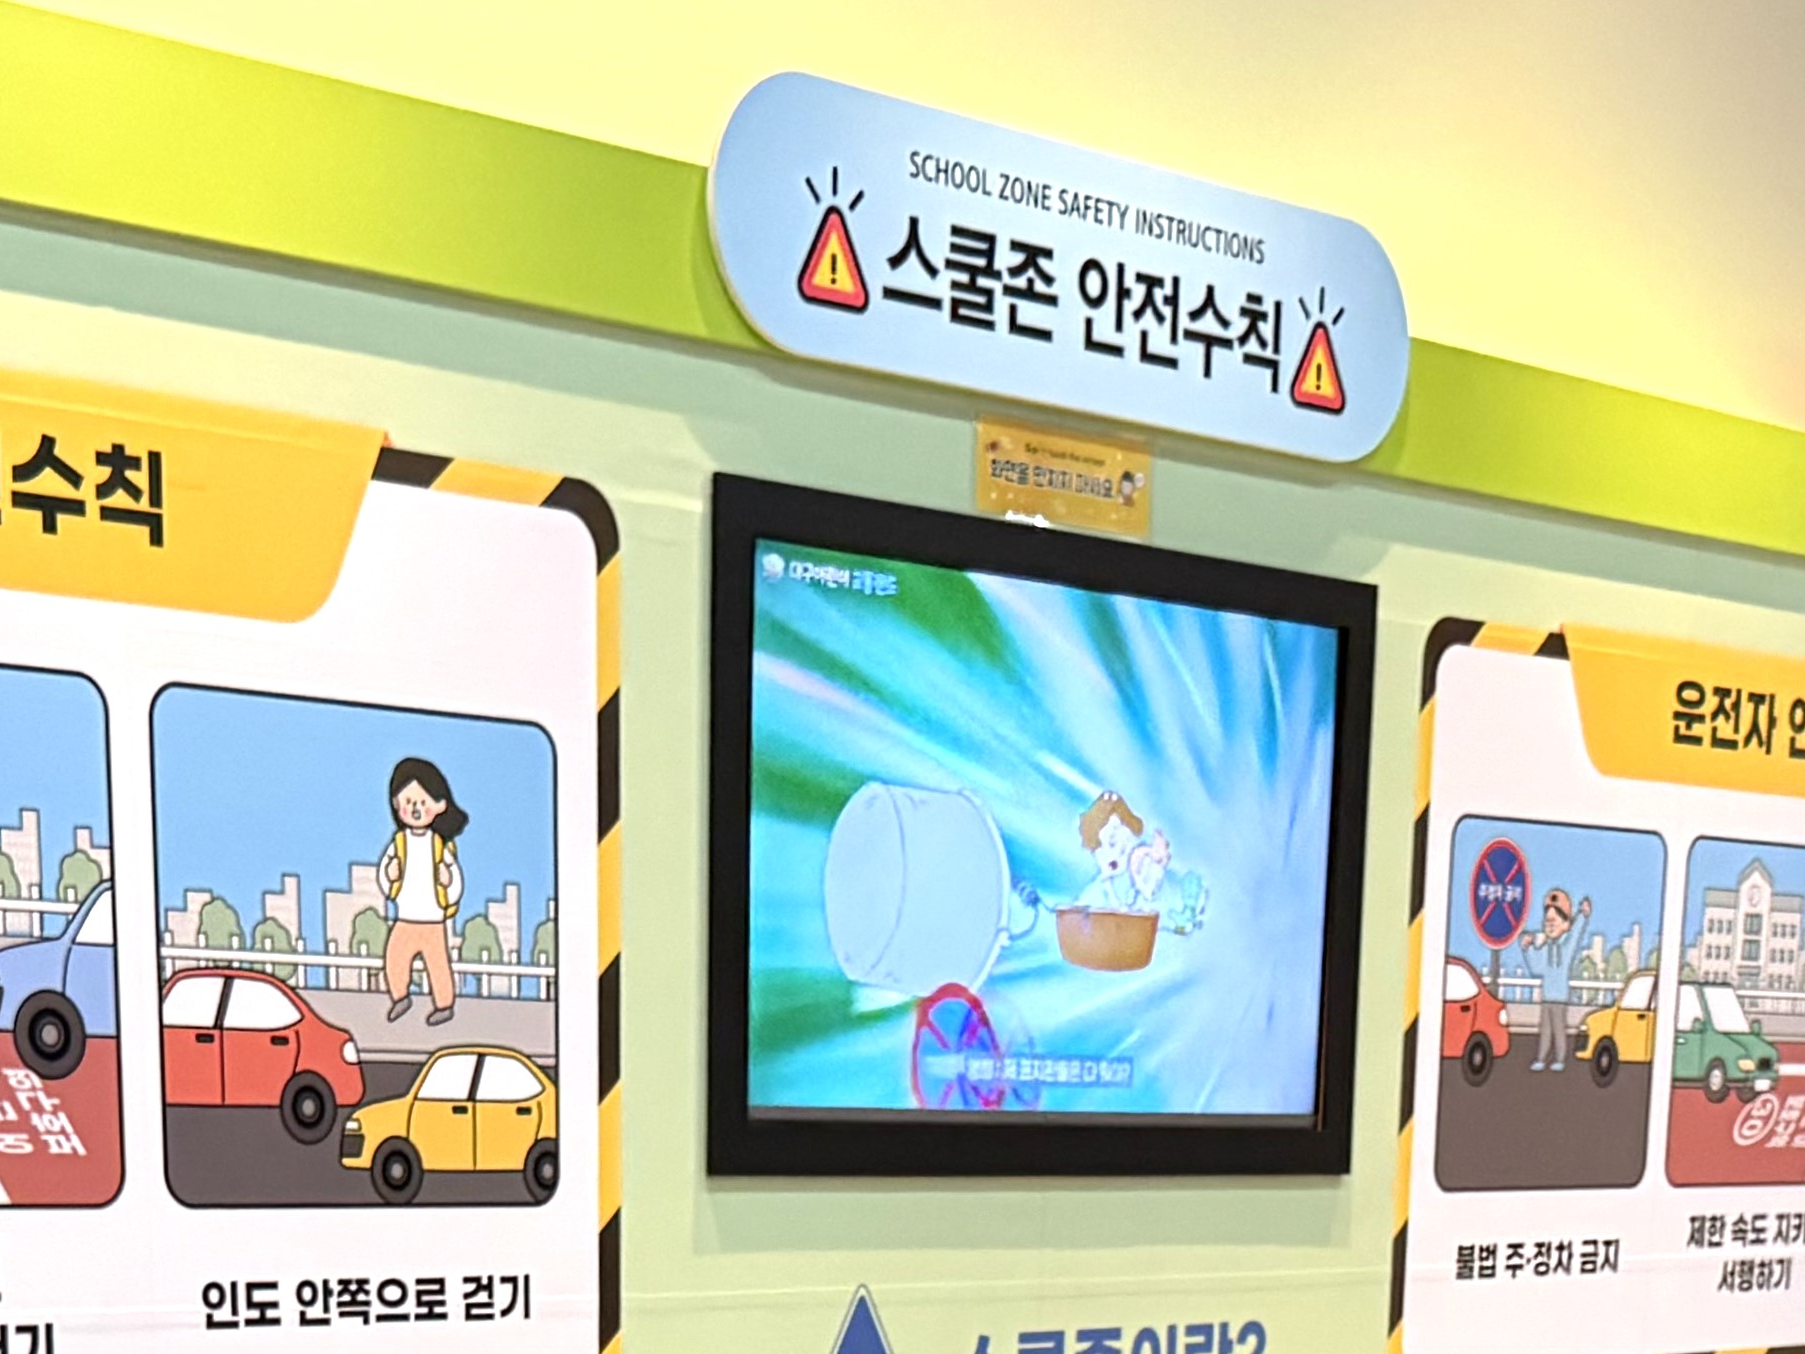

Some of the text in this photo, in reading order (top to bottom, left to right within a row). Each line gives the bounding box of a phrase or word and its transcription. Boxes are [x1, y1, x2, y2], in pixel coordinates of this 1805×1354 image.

[909, 150, 1266, 265] SCHOOL ZONE SAFETY INSTRUCTIONS
[882, 216, 1283, 394] 스쿨존 안전수칙
[1672, 679, 1777, 756] 운전자
[1455, 1242, 1498, 1281] 불법
[1579, 1238, 1621, 1275] 금지
[1686, 1213, 1726, 1249] 제한
[1730, 1212, 1769, 1248] 속도
[201, 1273, 533, 1331] 인도 안쪽으로 걷기
[1716, 1257, 1794, 1294] 서행하기
